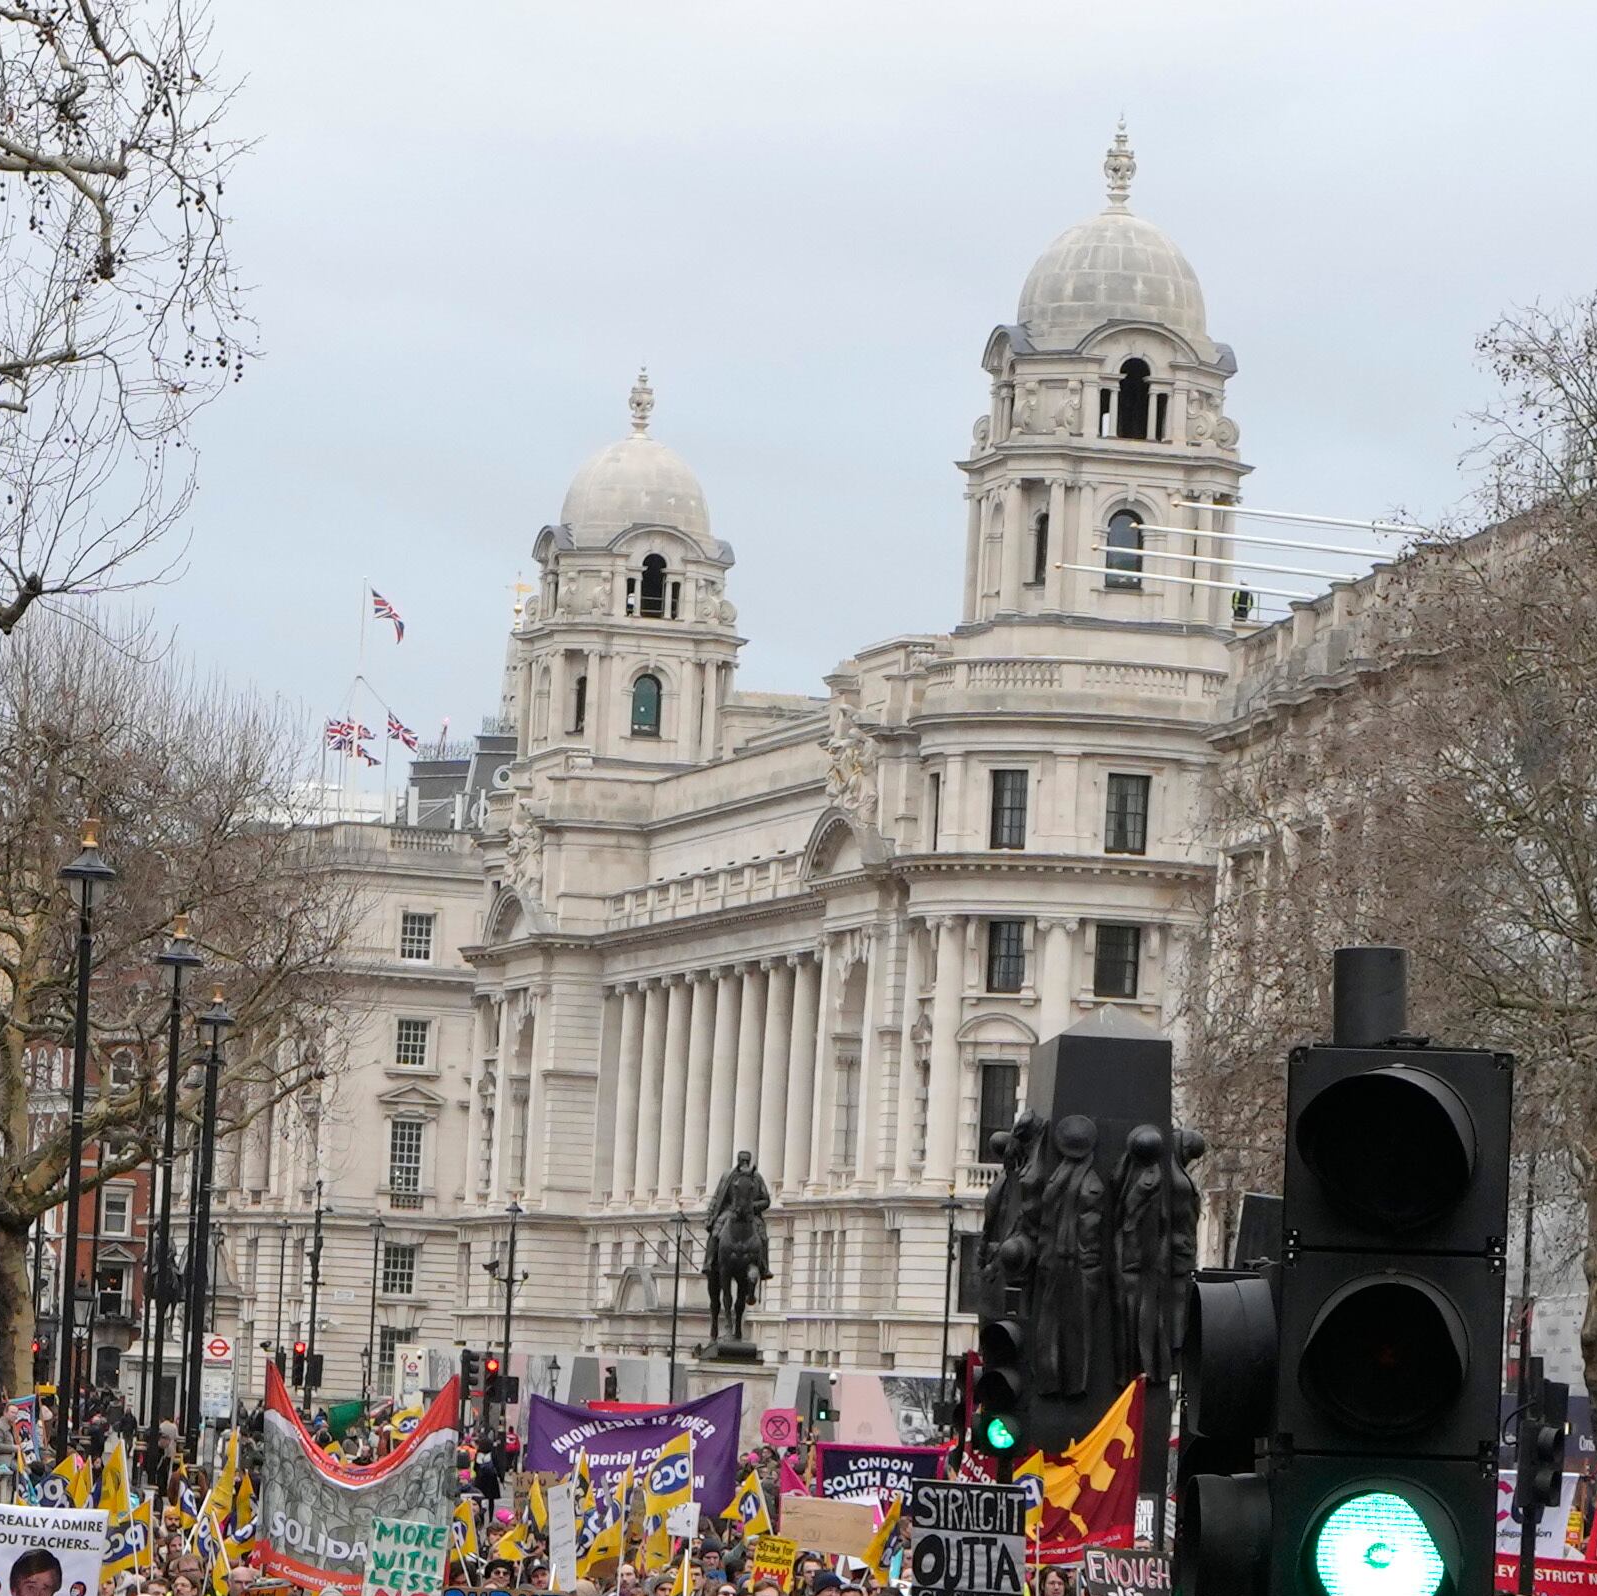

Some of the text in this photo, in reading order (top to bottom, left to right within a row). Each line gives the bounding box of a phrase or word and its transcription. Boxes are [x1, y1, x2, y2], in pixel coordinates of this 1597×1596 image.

[652, 1416, 668, 1426] IS
[848, 1458, 914, 1472] LONDON
[822, 1471, 882, 1496] SOUTH
[915, 1487, 1024, 1535] STRAIGHT
[52, 1518, 103, 1533] ADMIRE
[372, 1550, 437, 1572] WITH
[912, 1533, 1022, 1592] OUTTA
[1087, 1551, 1172, 1589] ENOUGH
